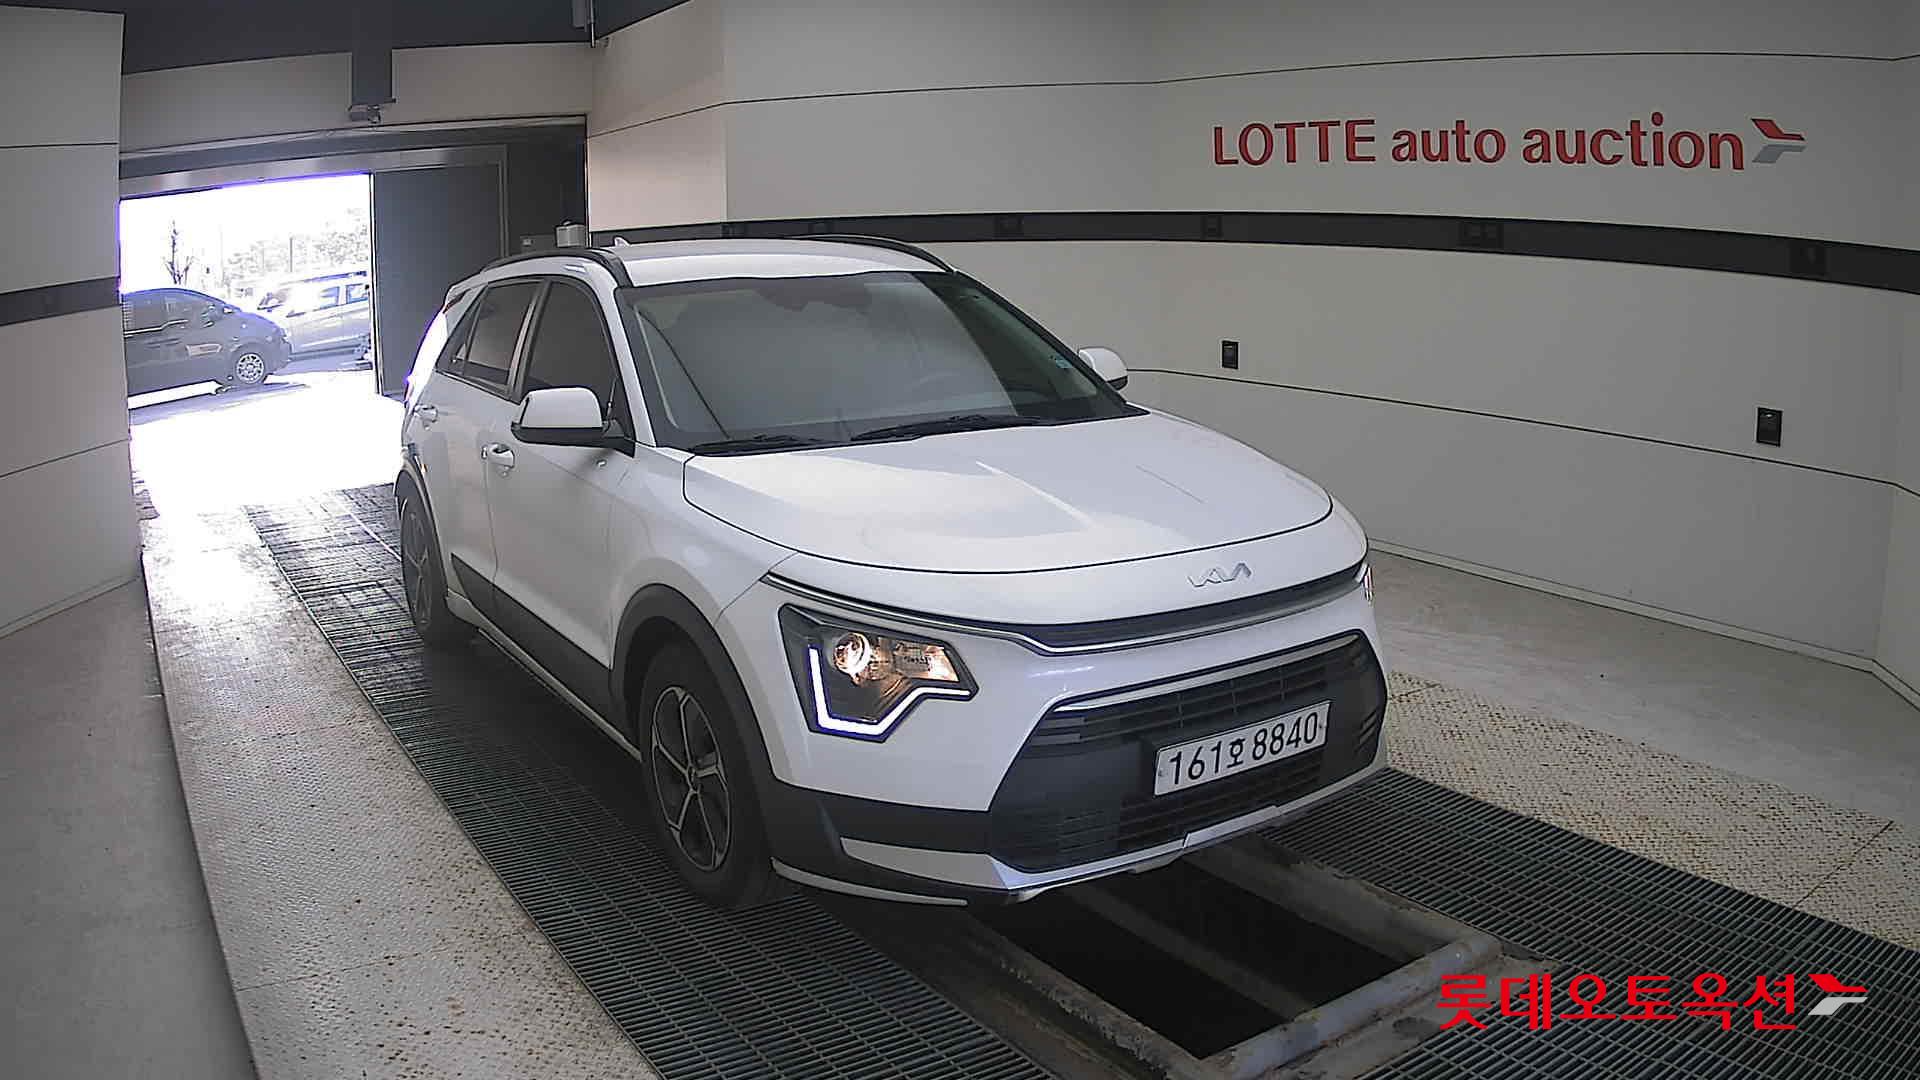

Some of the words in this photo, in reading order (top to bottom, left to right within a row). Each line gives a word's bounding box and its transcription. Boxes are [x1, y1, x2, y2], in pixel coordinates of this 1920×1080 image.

[1213, 119, 1376, 165] LOTTE
[1391, 120, 1507, 164] auto
[1522, 112, 1745, 170] auction
